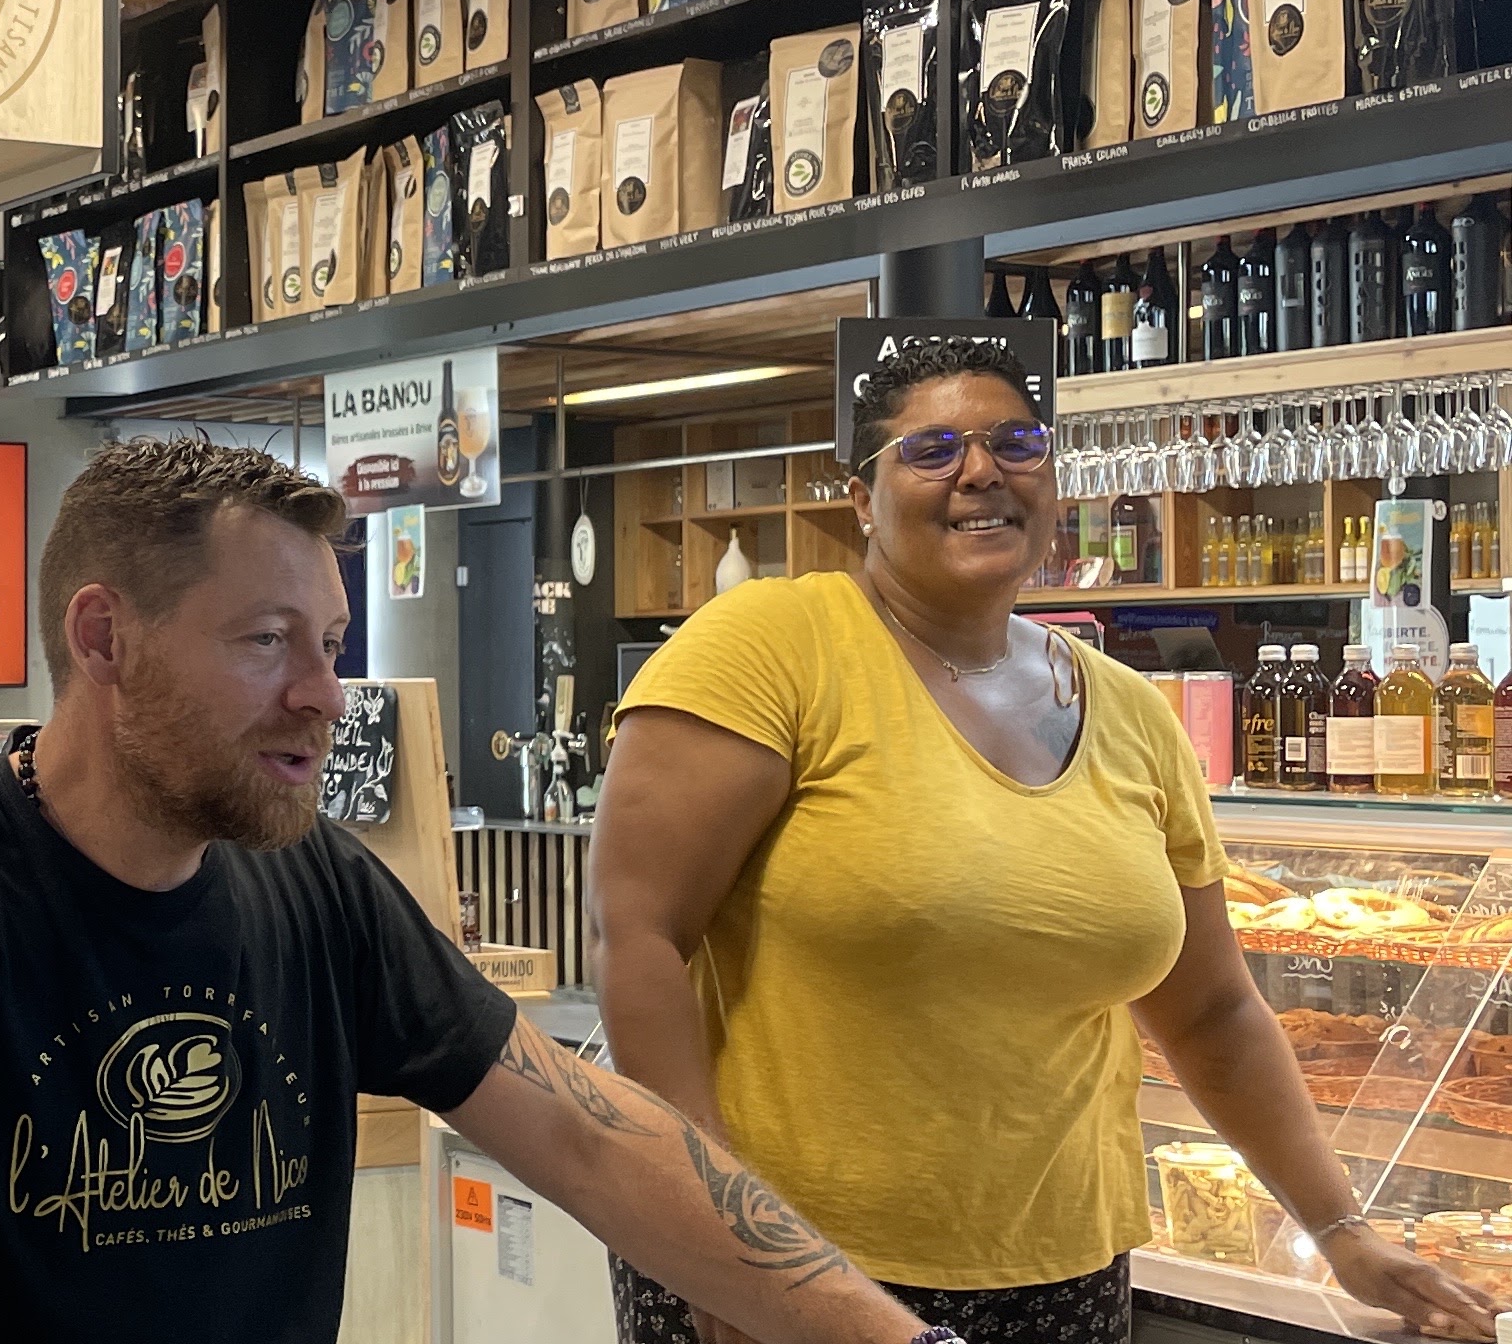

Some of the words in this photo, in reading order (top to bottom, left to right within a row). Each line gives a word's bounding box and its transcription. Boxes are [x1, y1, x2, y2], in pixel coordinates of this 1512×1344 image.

[331, 389, 358, 419] LA
[362, 379, 433, 414] BANOU
[473, 959, 534, 978] AP'MUNDO
[31, 993, 133, 1086] ARTISAN
[9, 1109, 189, 1254] l'Atelier
[199, 1135, 240, 1208] de
[251, 1098, 309, 1210] Nico
[156, 1222, 196, 1242] THÉS
[202, 1223, 215, 1238] &
